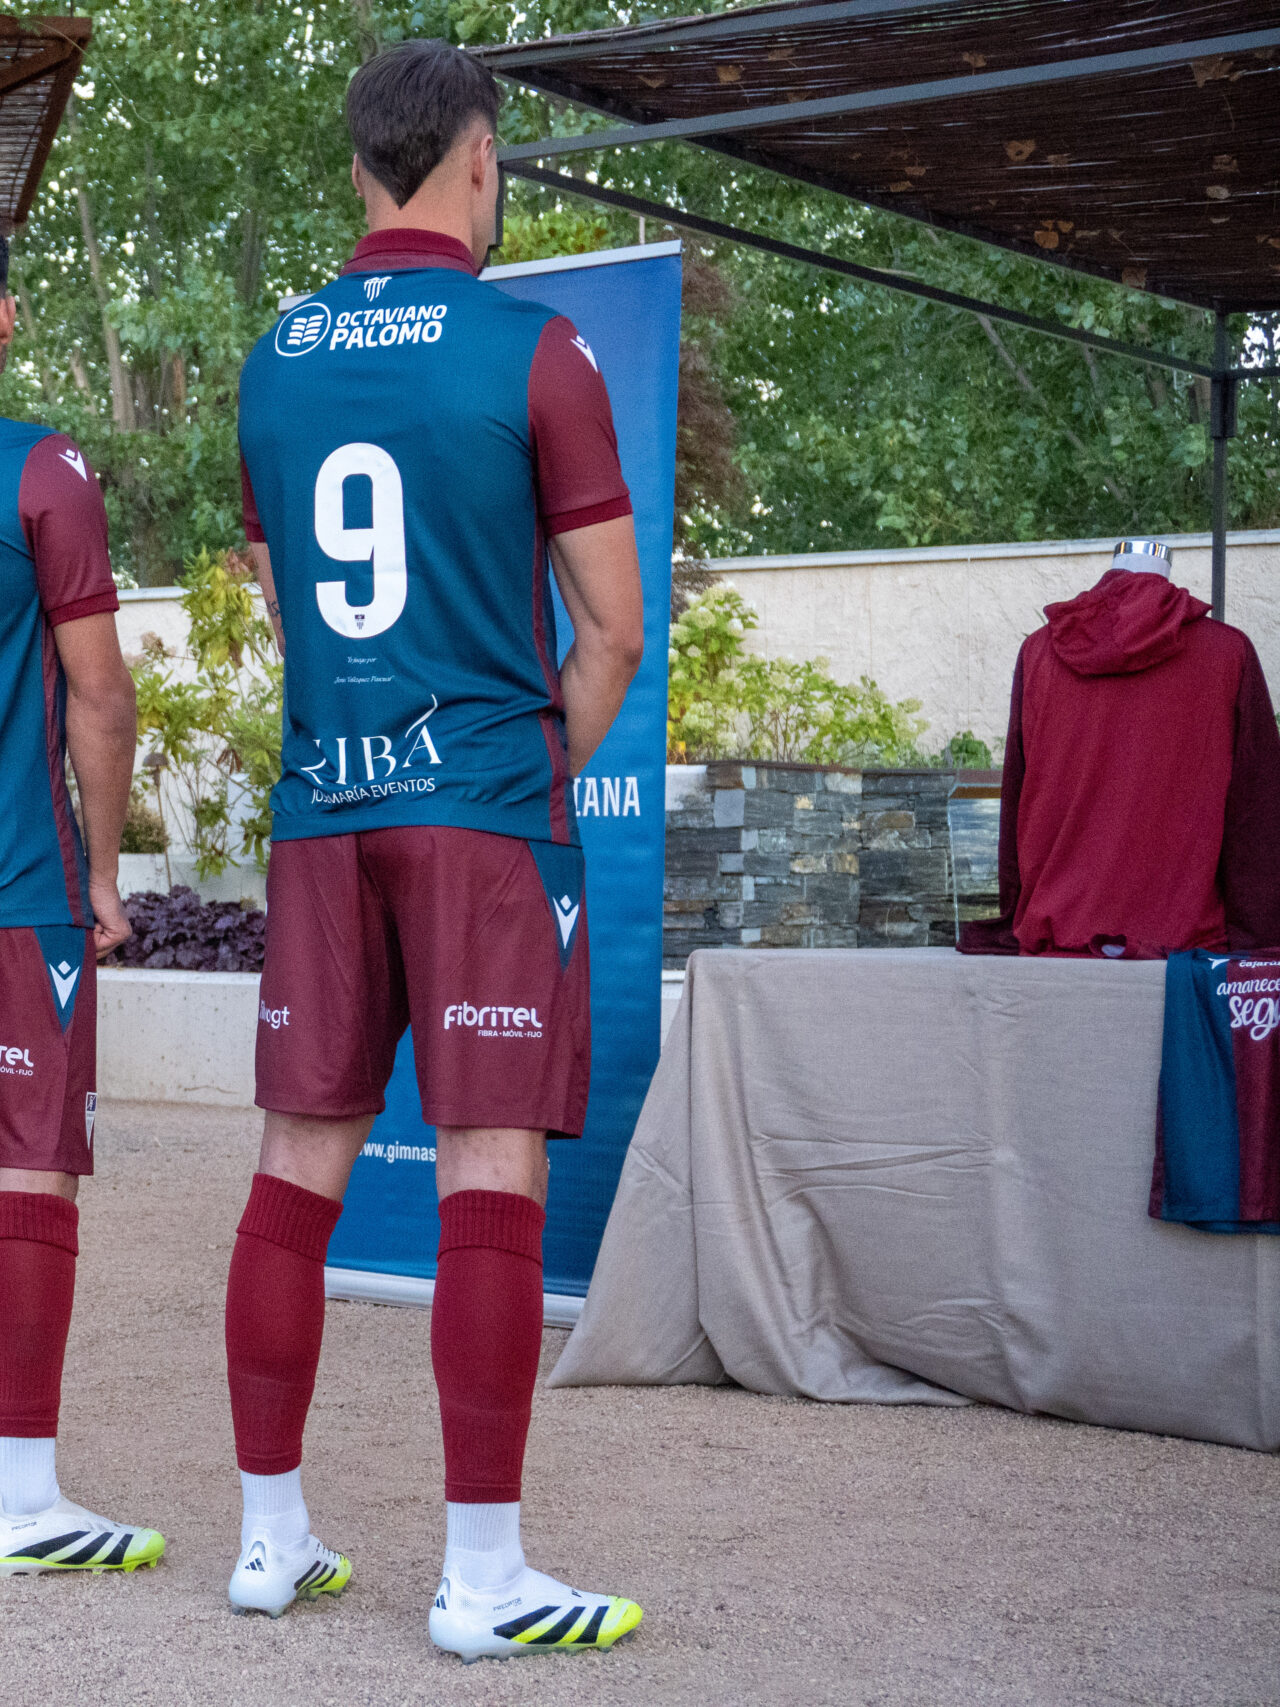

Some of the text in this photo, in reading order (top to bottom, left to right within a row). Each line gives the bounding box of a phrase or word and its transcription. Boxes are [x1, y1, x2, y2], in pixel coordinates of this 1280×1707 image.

[336, 304, 448, 328] OCTAVIANO
[329, 320, 443, 351] PALOMO
[314, 442, 408, 639] 9
[329, 785, 370, 804] MARÍA
[370, 777, 436, 798] EVENTOS
[502, 1029, 523, 1037] MÓVIL
[18, 1068, 34, 1076] FIJO
